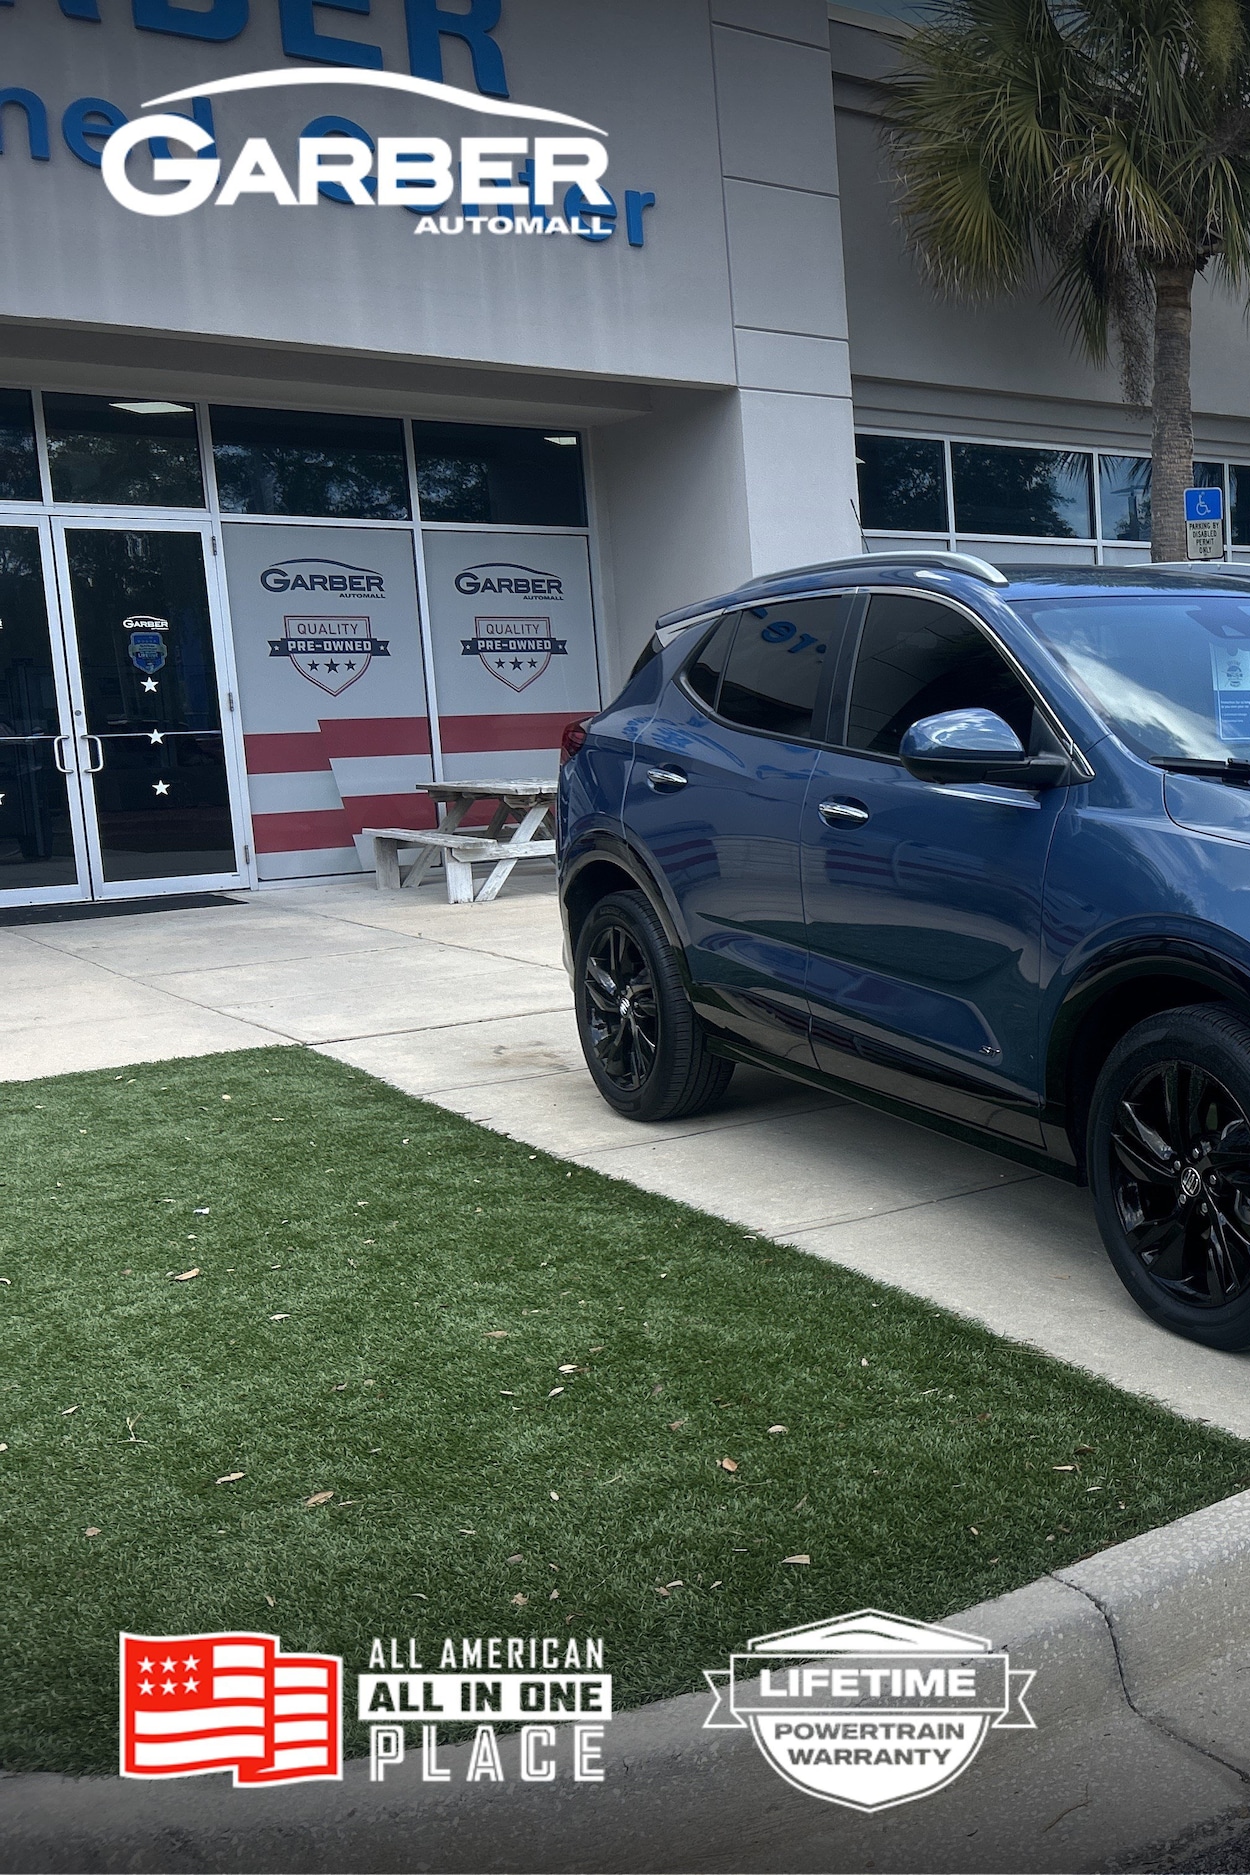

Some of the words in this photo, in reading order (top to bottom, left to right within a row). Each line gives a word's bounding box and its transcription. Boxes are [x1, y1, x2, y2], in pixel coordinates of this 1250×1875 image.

[1189, 522, 1211, 530] PARKING
[1193, 530, 1217, 538] DISABLED
[1196, 538, 1214, 546] PERMIT
[260, 568, 385, 593] GARBER
[454, 572, 564, 595] GARBER
[122, 619, 169, 628] GARBER
[297, 623, 358, 635] QUALITY
[486, 623, 540, 635] QUALITY
[287, 640, 372, 652] PRE-OWNED
[477, 640, 552, 651] PRE-OWNED
